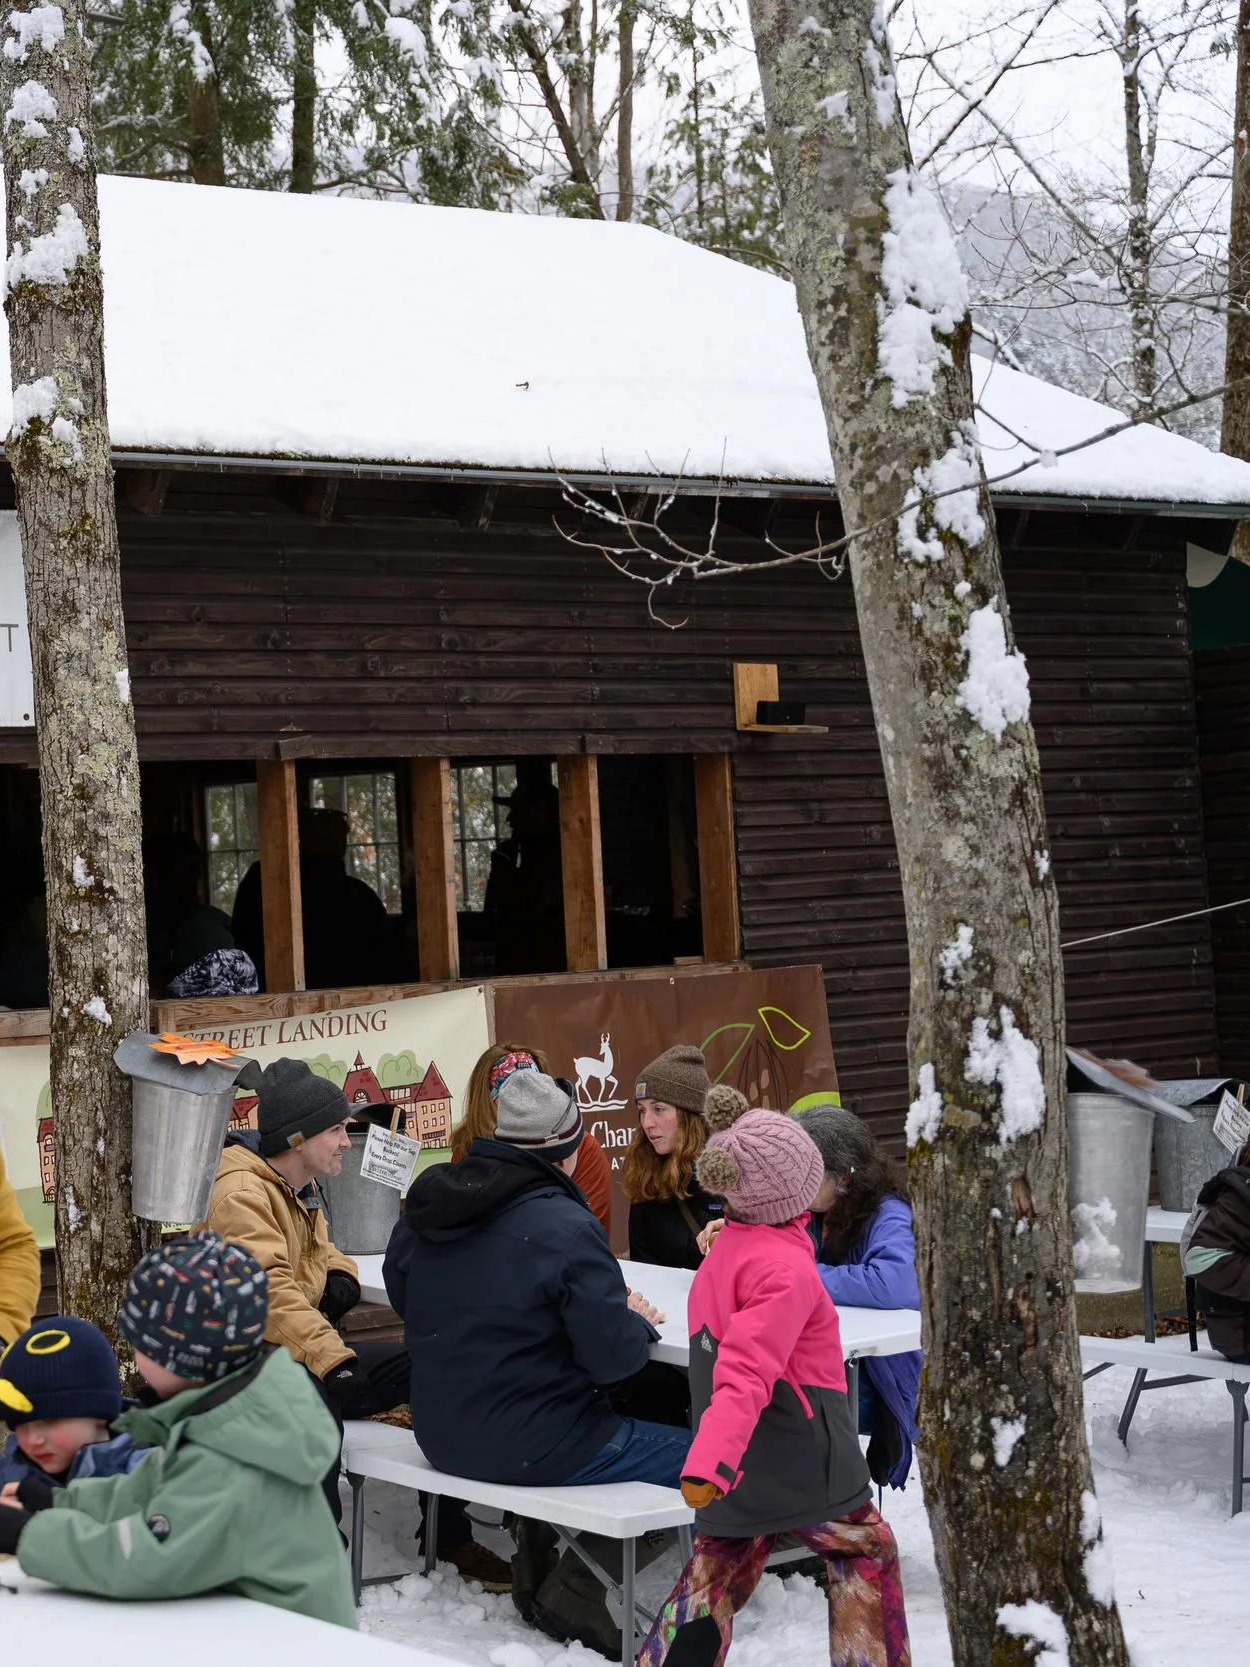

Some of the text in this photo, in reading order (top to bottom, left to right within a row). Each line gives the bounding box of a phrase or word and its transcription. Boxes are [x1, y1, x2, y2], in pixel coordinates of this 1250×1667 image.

[277, 1009, 388, 1044] LANDING
[384, 1139, 393, 1147] Help
[371, 1152, 382, 1160] Every
[382, 1155, 392, 1164] Drop
